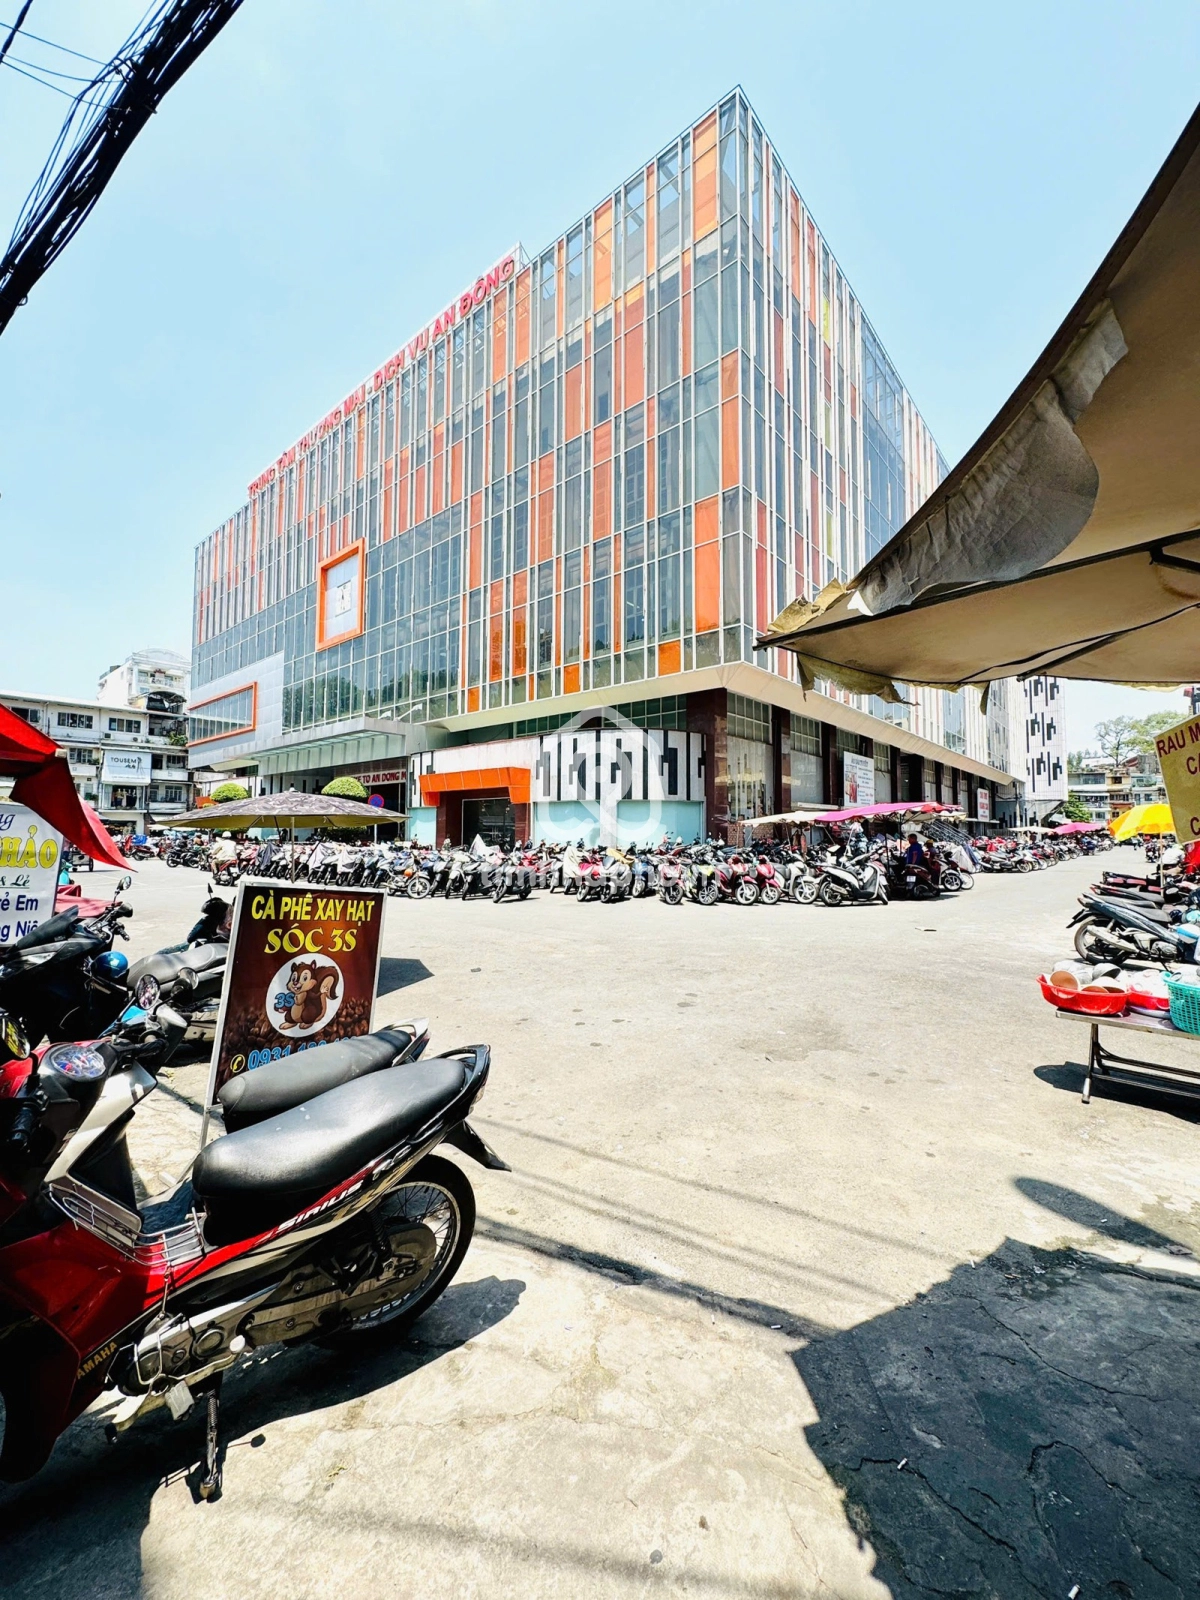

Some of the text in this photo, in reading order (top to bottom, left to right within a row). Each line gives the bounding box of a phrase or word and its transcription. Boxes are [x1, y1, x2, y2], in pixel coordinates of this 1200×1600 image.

[248, 465, 275, 498] TRUNG
[373, 349, 405, 392] DỊCH
[432, 304, 456, 343] AN
[459, 255, 515, 318] ĐÔNG
[1156, 729, 1186, 758] RAU
[110, 756, 137, 764] TOUSEM
[363, 775, 370, 784] TO
[372, 773, 380, 783] AN
[382, 771, 400, 782] DONG
[0, 825, 58, 869] HẢO
[15, 895, 39, 911] Em
[251, 889, 375, 927] CÀ PHÊ XAY HẠT
[264, 922, 357, 954] SÓC 3S
[275, 993, 295, 1009] 3S
[275, 1180, 364, 1235] SIRIUS
[76, 1341, 118, 1380] AMAHA
